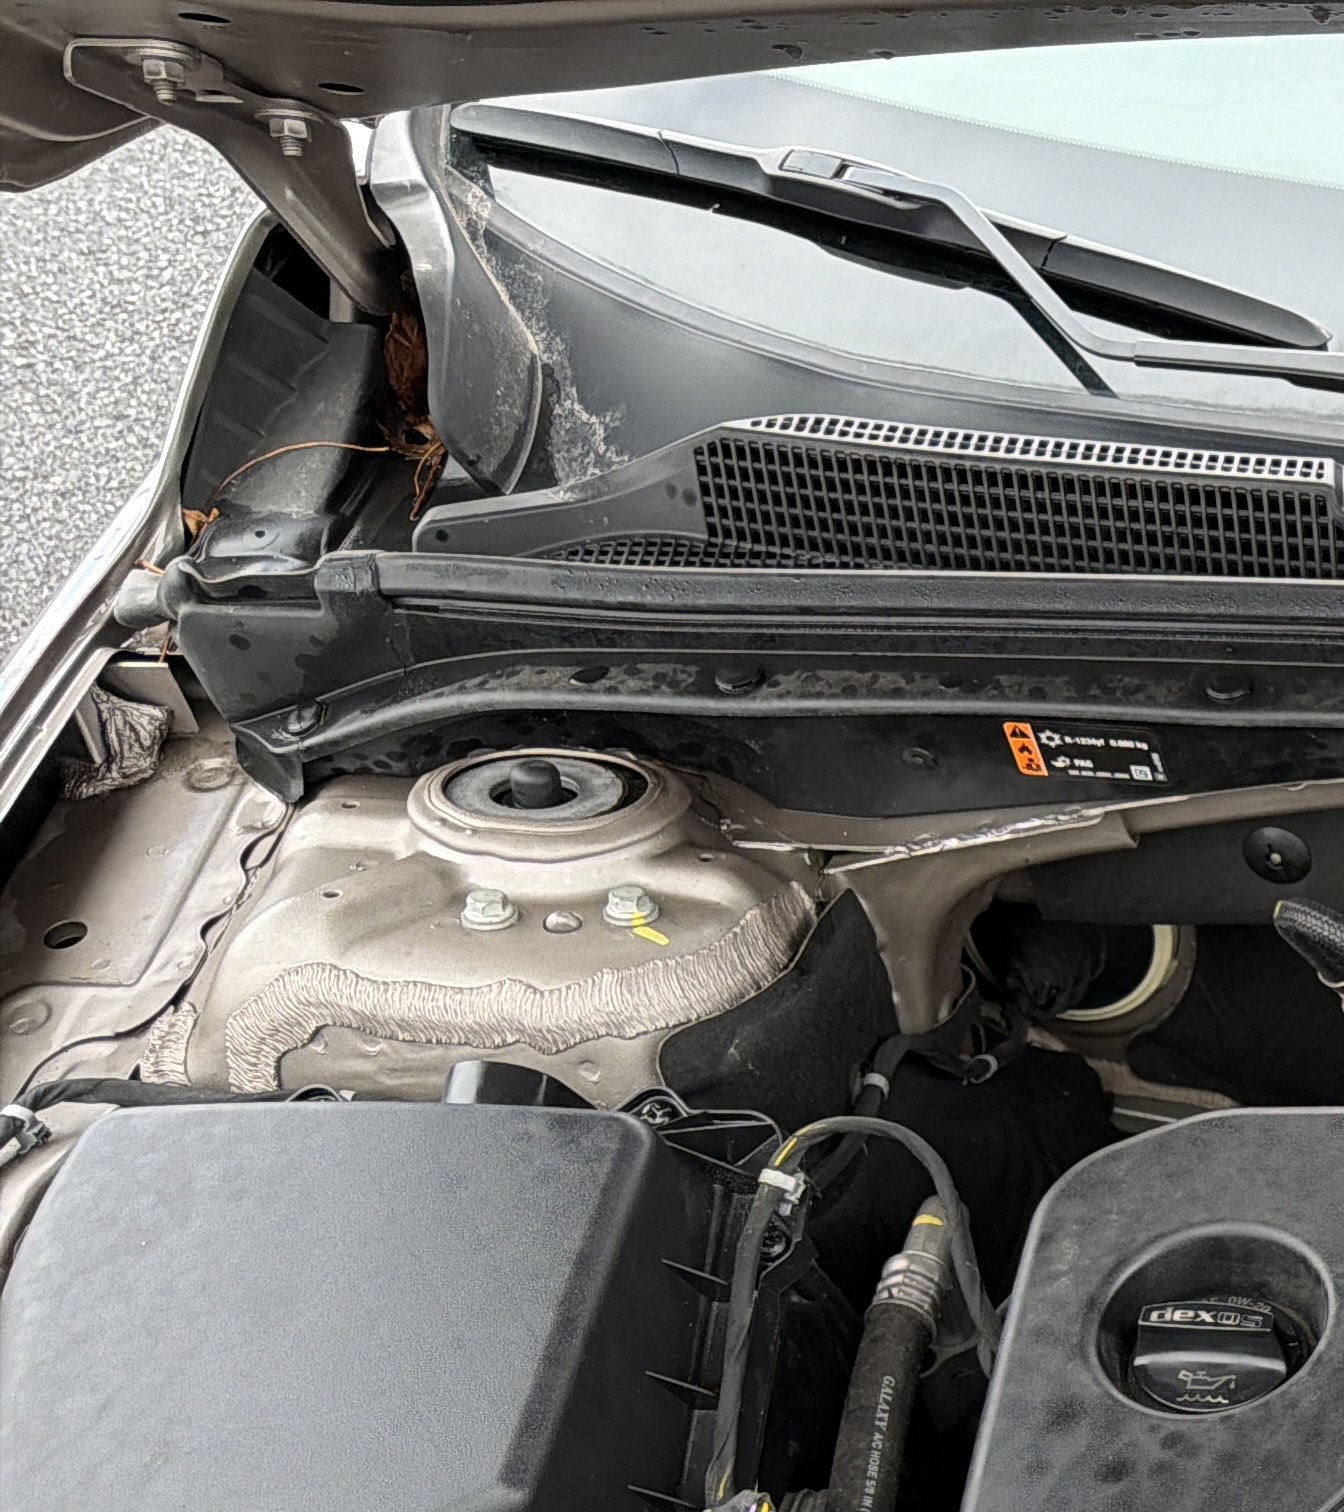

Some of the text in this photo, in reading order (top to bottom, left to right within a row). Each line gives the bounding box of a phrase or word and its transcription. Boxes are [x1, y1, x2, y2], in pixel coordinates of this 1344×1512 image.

[1149, 1306, 1264, 1329] dexos
[874, 1375, 896, 1432] GALAXY
[866, 1450, 882, 1481] HOSE
